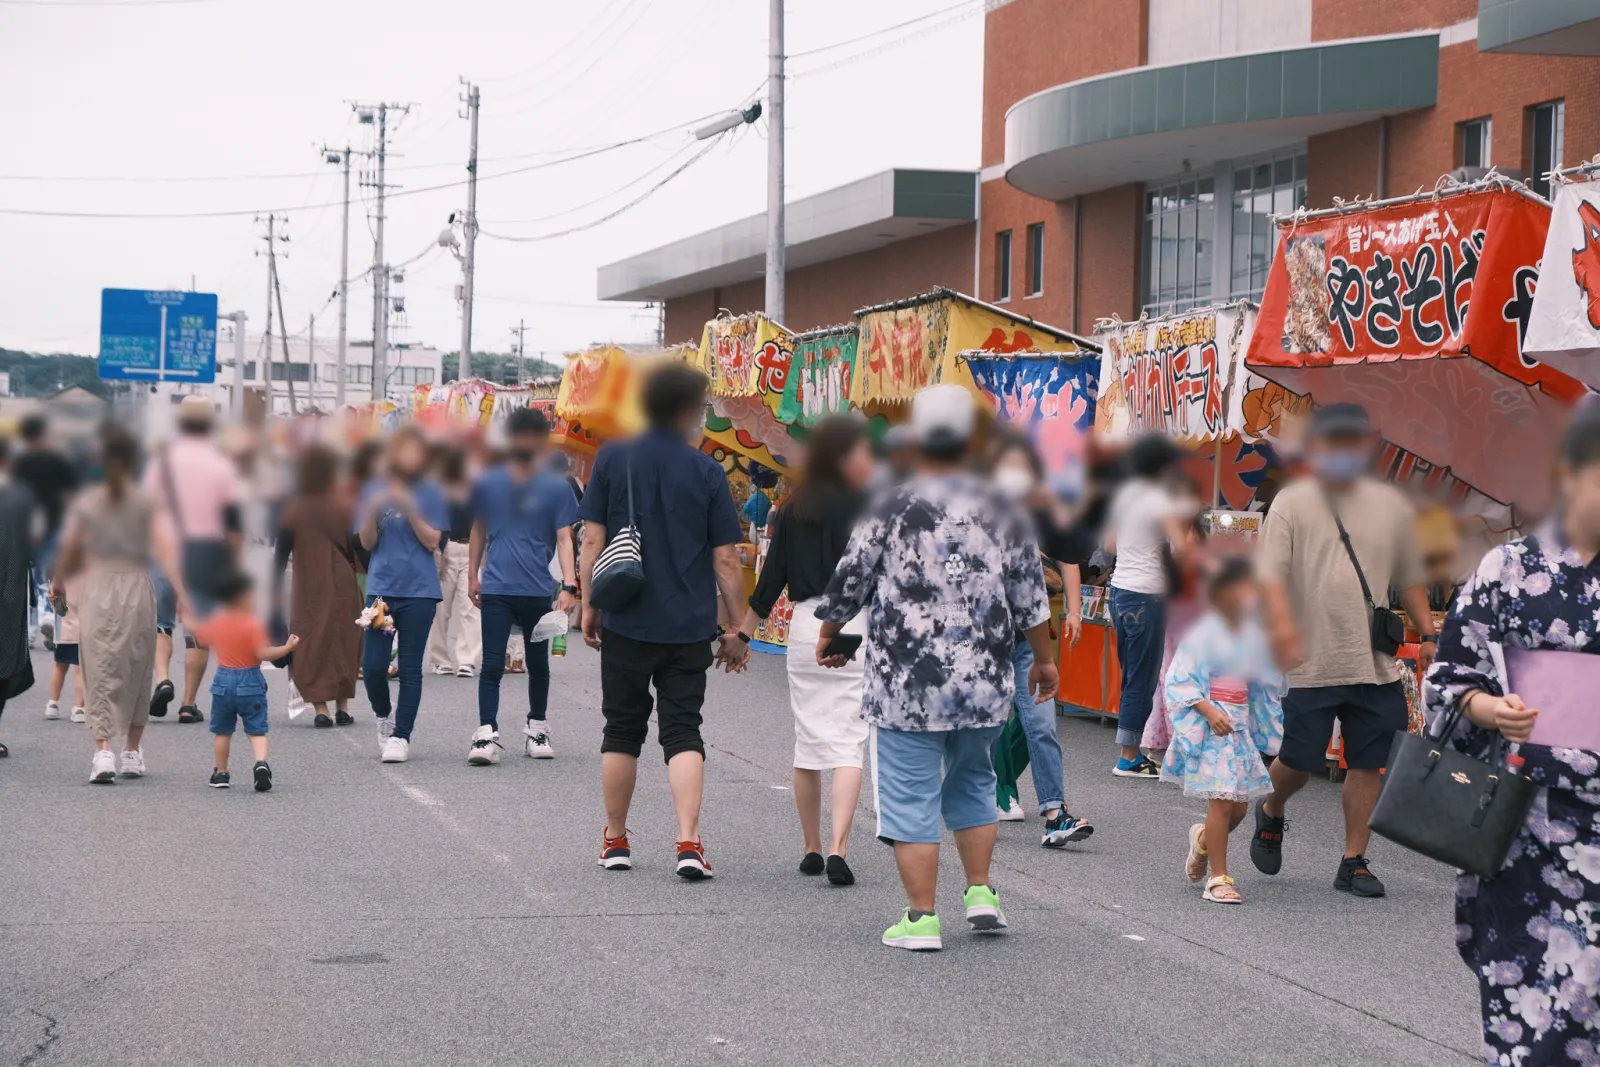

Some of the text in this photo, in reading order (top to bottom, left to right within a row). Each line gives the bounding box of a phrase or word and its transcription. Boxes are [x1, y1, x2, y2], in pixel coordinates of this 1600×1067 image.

[1347, 210, 1459, 253] 旨ソースあげ玉入
[1123, 340, 1222, 434] カリカリチーズ
